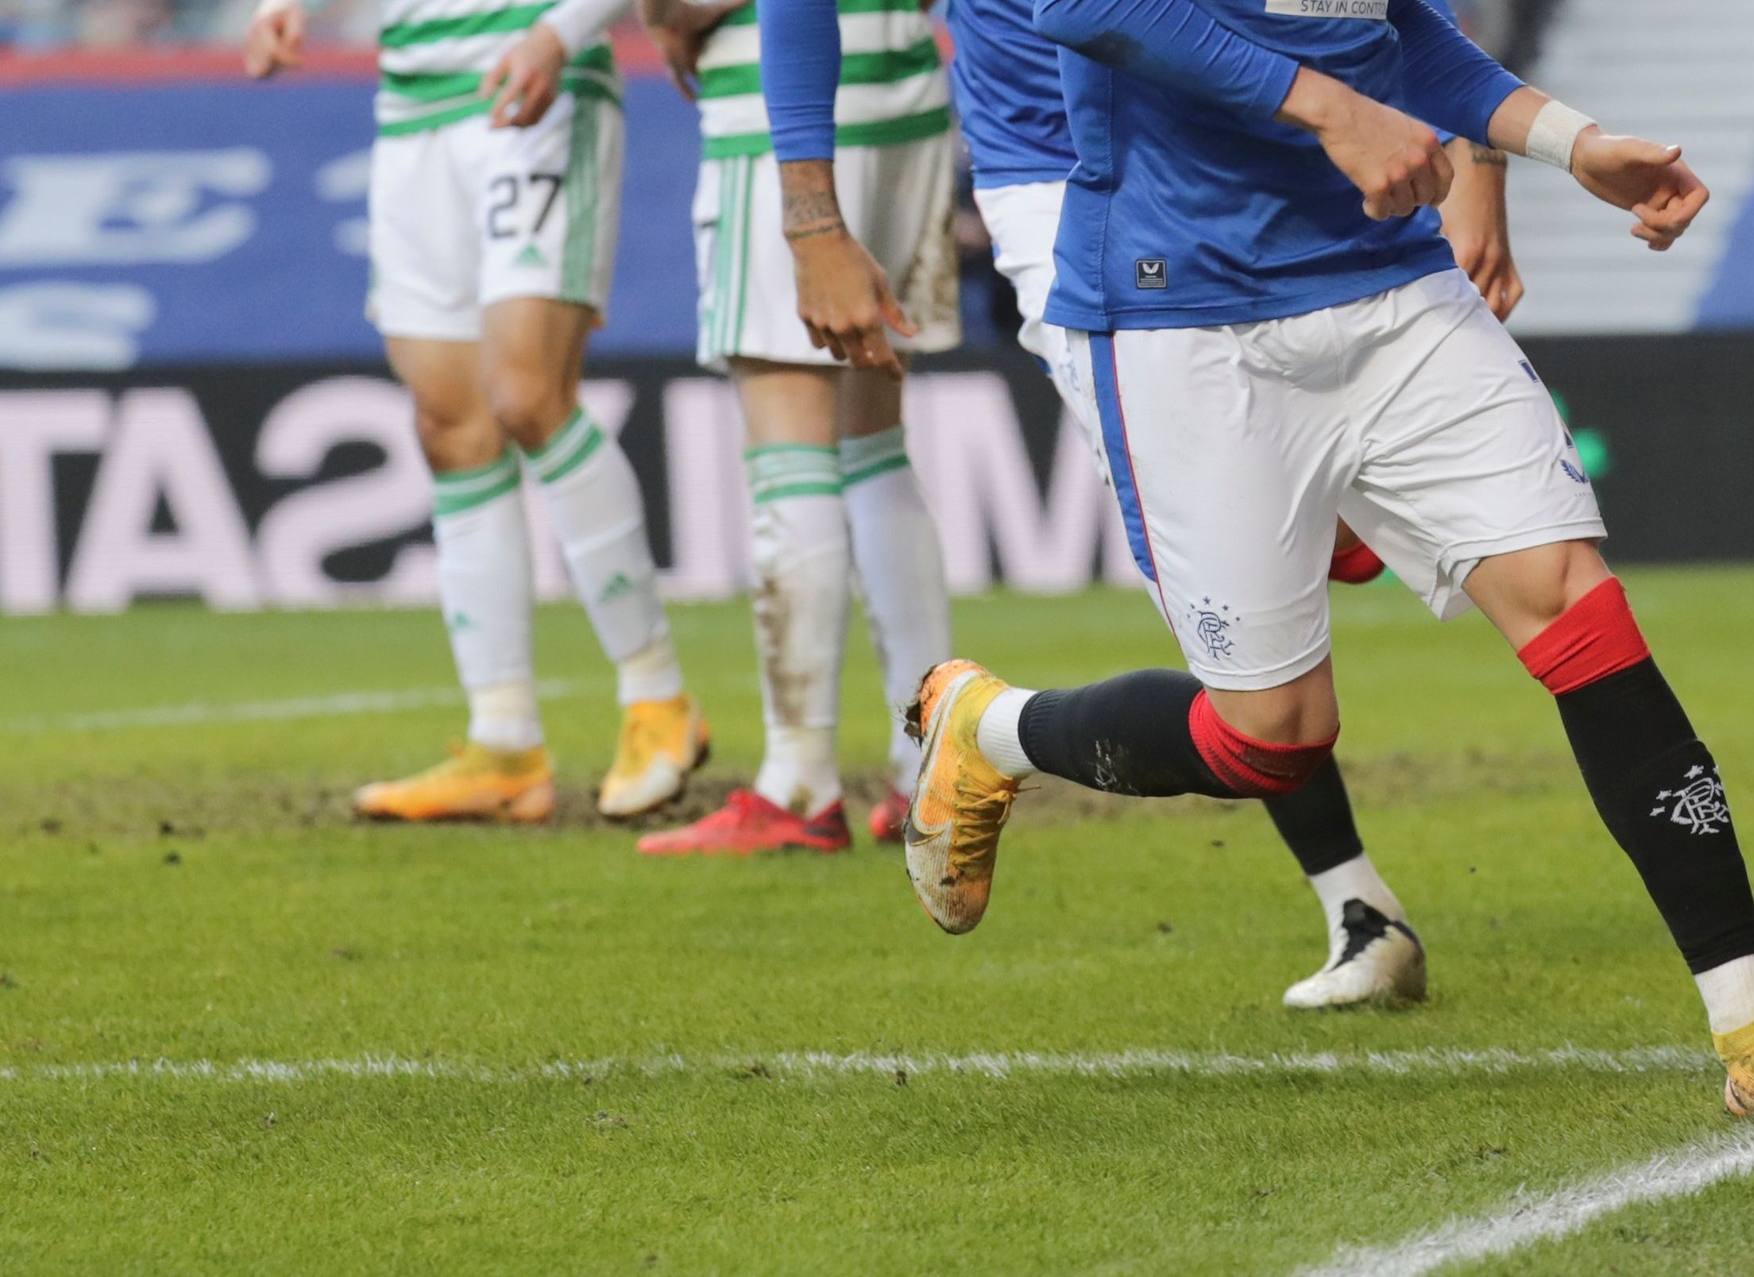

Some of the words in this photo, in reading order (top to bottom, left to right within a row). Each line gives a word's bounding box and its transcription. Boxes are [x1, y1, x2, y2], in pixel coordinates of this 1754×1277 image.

[1301, 0, 1332, 12] STAY
[1335, 2, 1347, 14] IN
[488, 173, 565, 241] 27
